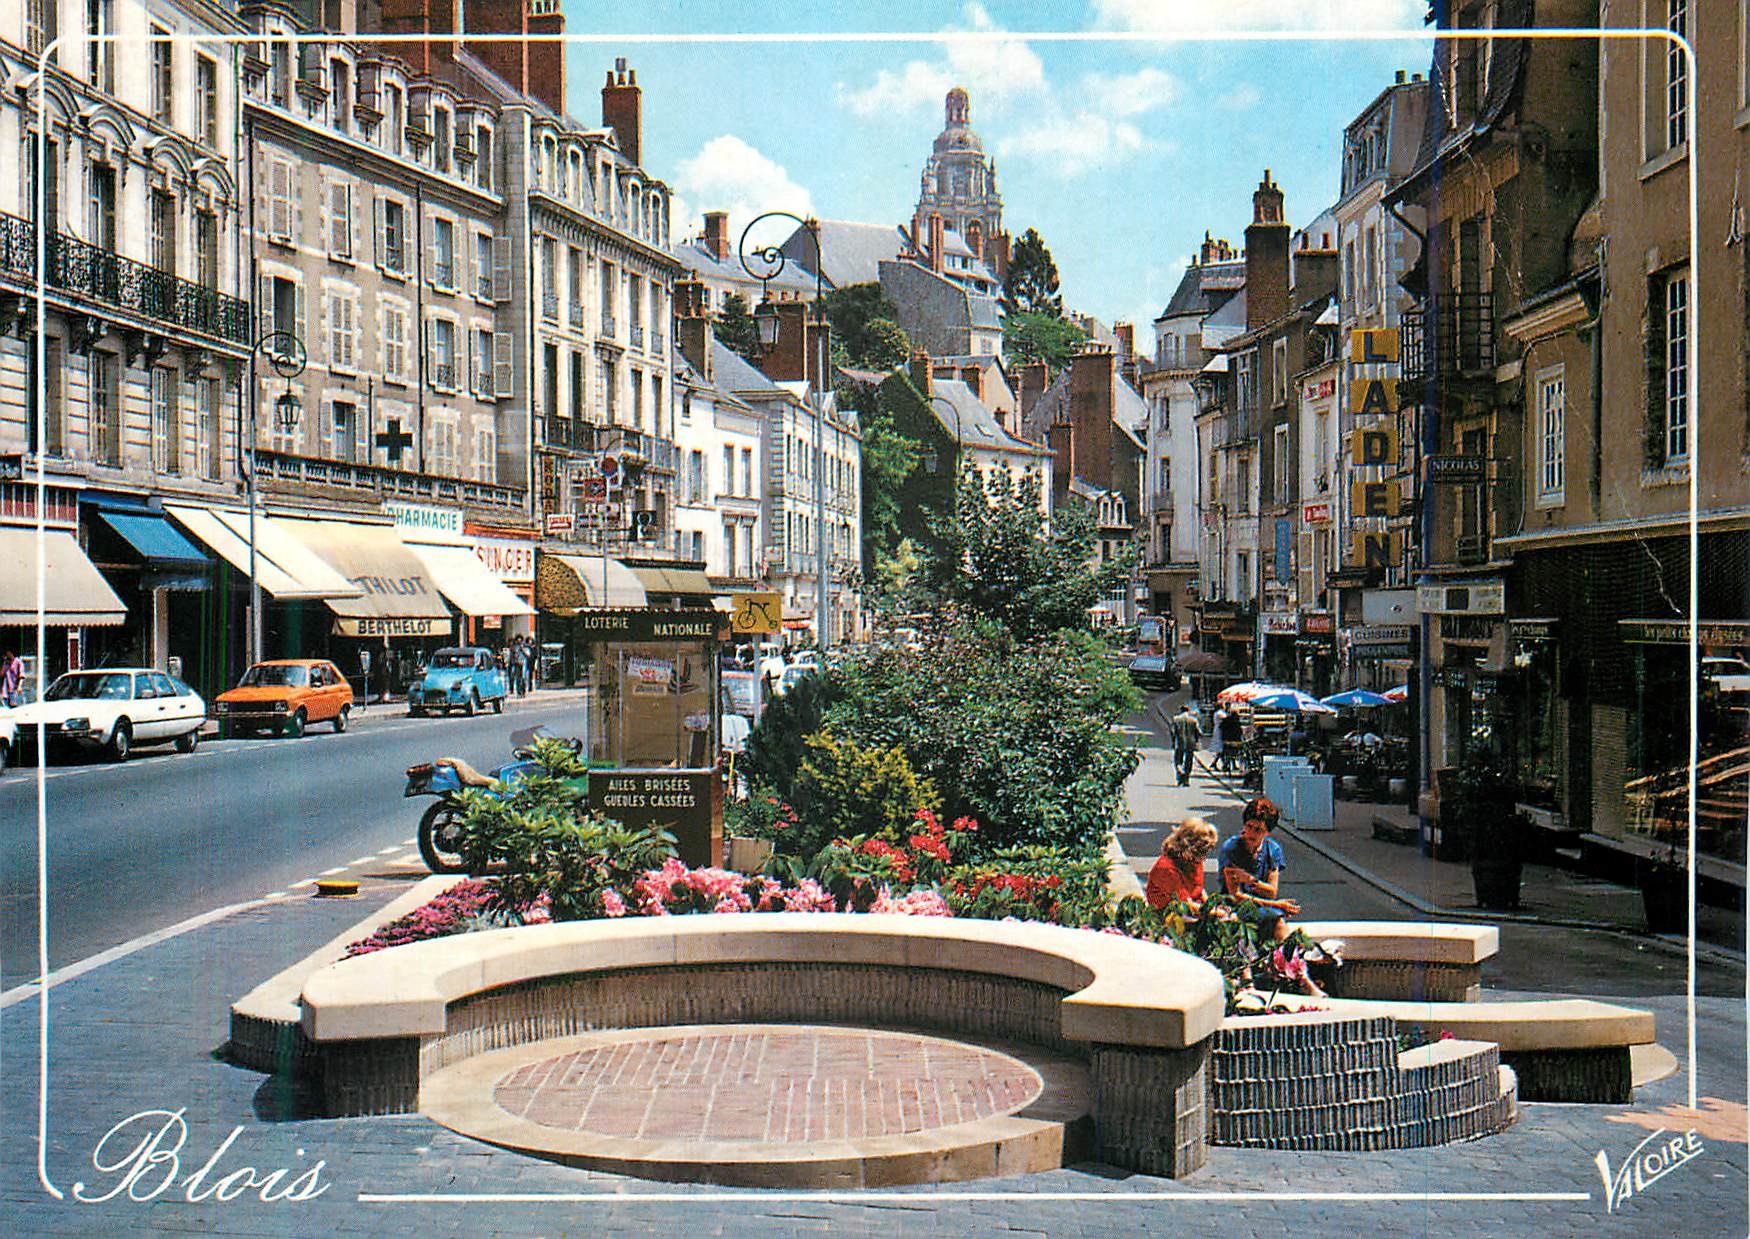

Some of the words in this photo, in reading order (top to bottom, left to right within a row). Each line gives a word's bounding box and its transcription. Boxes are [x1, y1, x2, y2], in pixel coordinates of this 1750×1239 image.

[1362, 331, 1390, 569] LADEN
[1432, 459, 1480, 472] NICOLAS
[386, 506, 459, 531] PHARMACIE
[476, 545, 532, 571] SINGER
[357, 619, 433, 635] BERTHELOT
[584, 617, 630, 630] LOTERIE
[653, 623, 714, 636] NATIONALE
[1354, 629, 1409, 642] CUISINES
[608, 779, 637, 792] AILES
[644, 776, 691, 792] BRISÉES
[603, 794, 646, 808] GUEULES
[650, 793, 696, 808] CASSÉES
